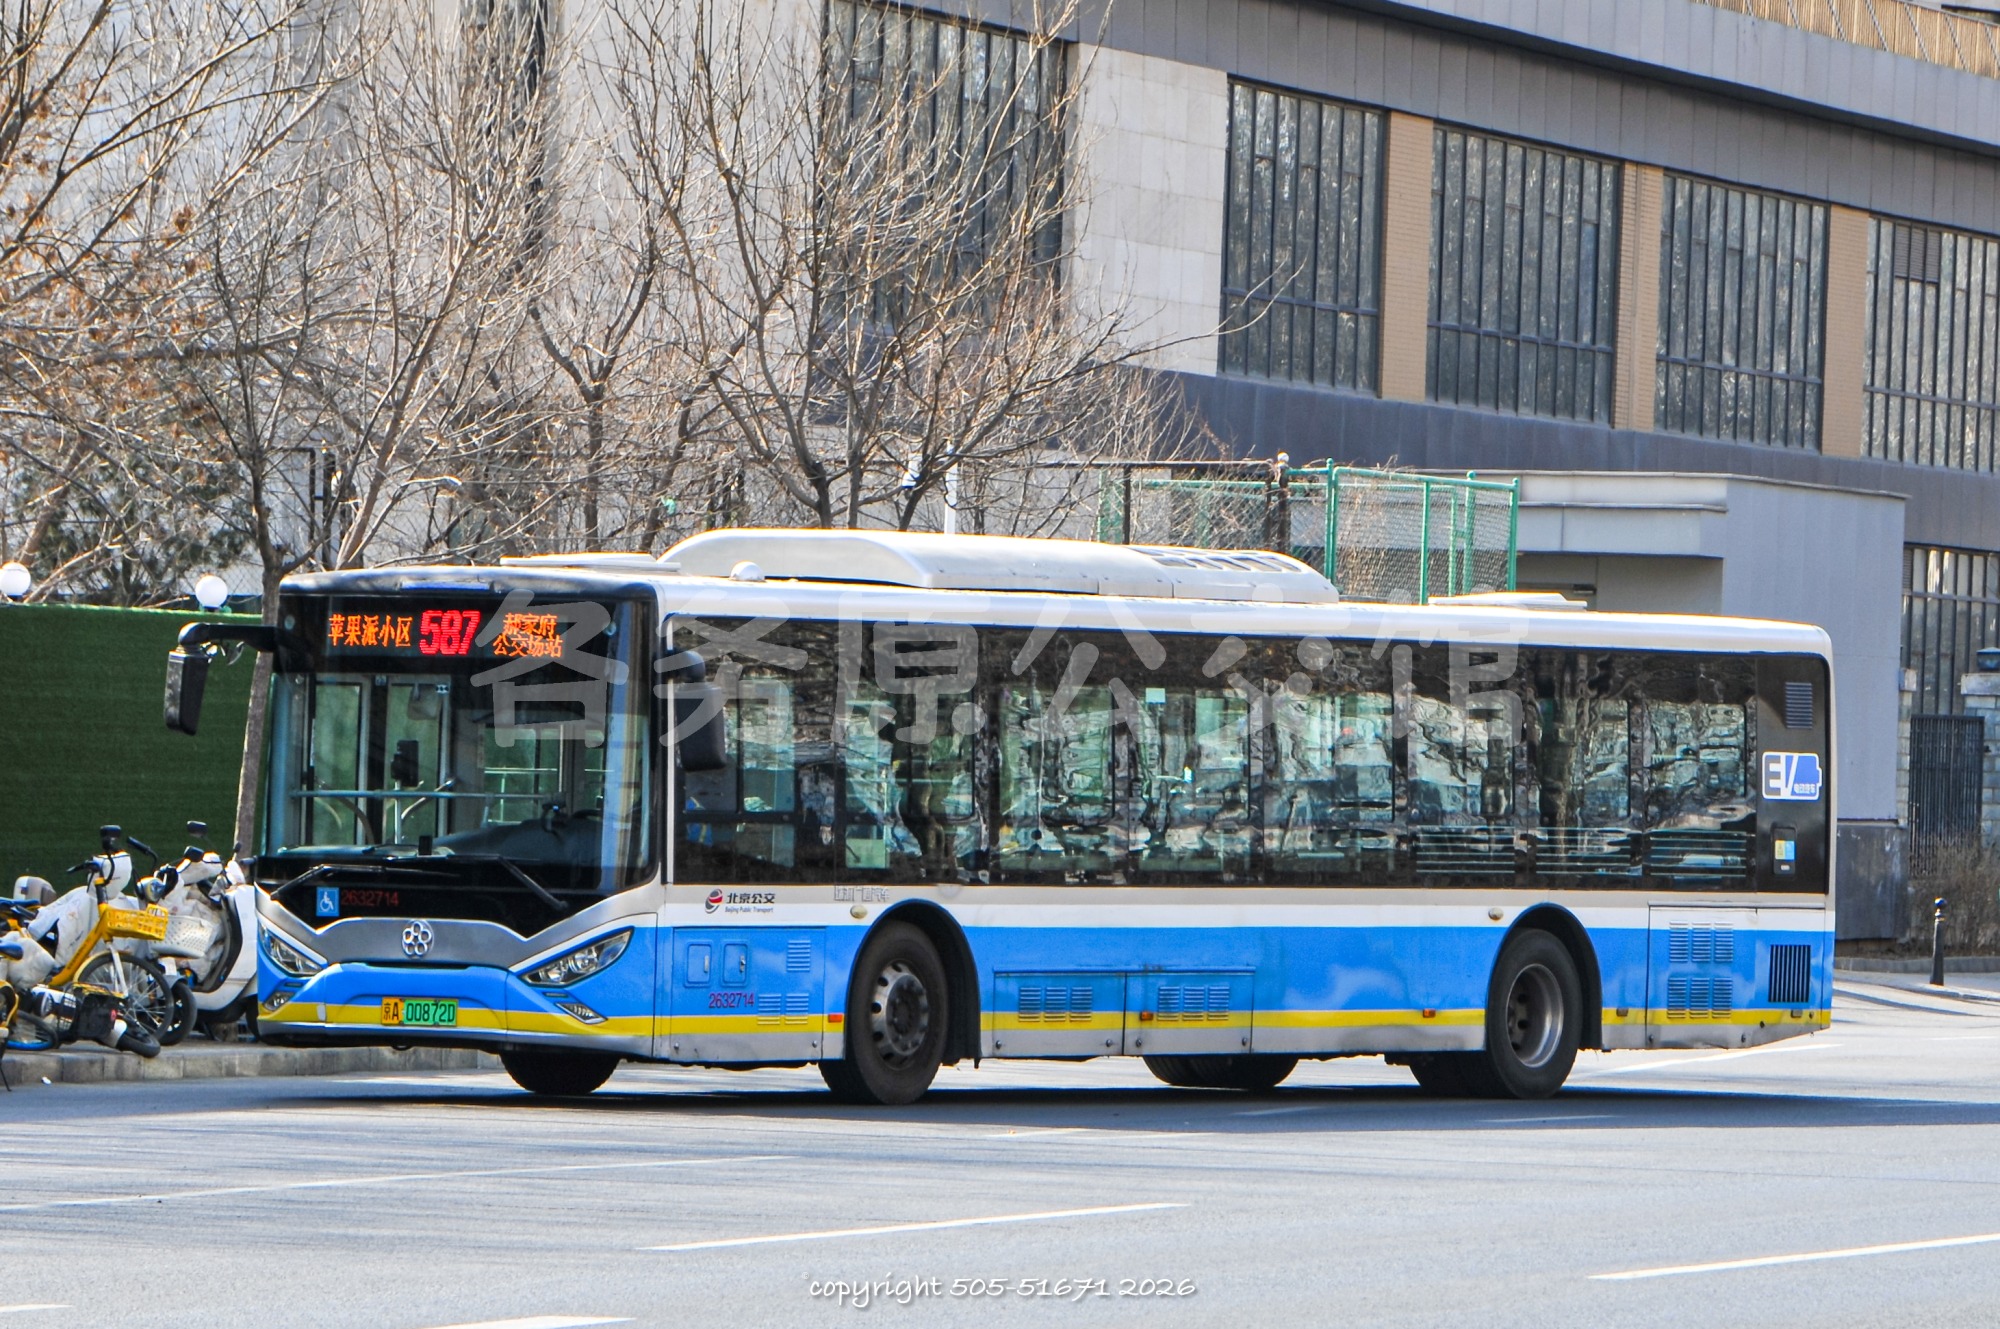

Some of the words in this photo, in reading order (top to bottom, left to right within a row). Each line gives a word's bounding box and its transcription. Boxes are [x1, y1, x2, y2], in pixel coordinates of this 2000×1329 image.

[327, 614, 413, 647] 苹果派小区
[419, 610, 481, 655] 587
[503, 613, 558, 637] 郝家府
[492, 633, 563, 657] 公交场站
[341, 890, 399, 907] 2632714
[726, 892, 776, 904] 北京公交
[708, 992, 755, 1008] 2632714
